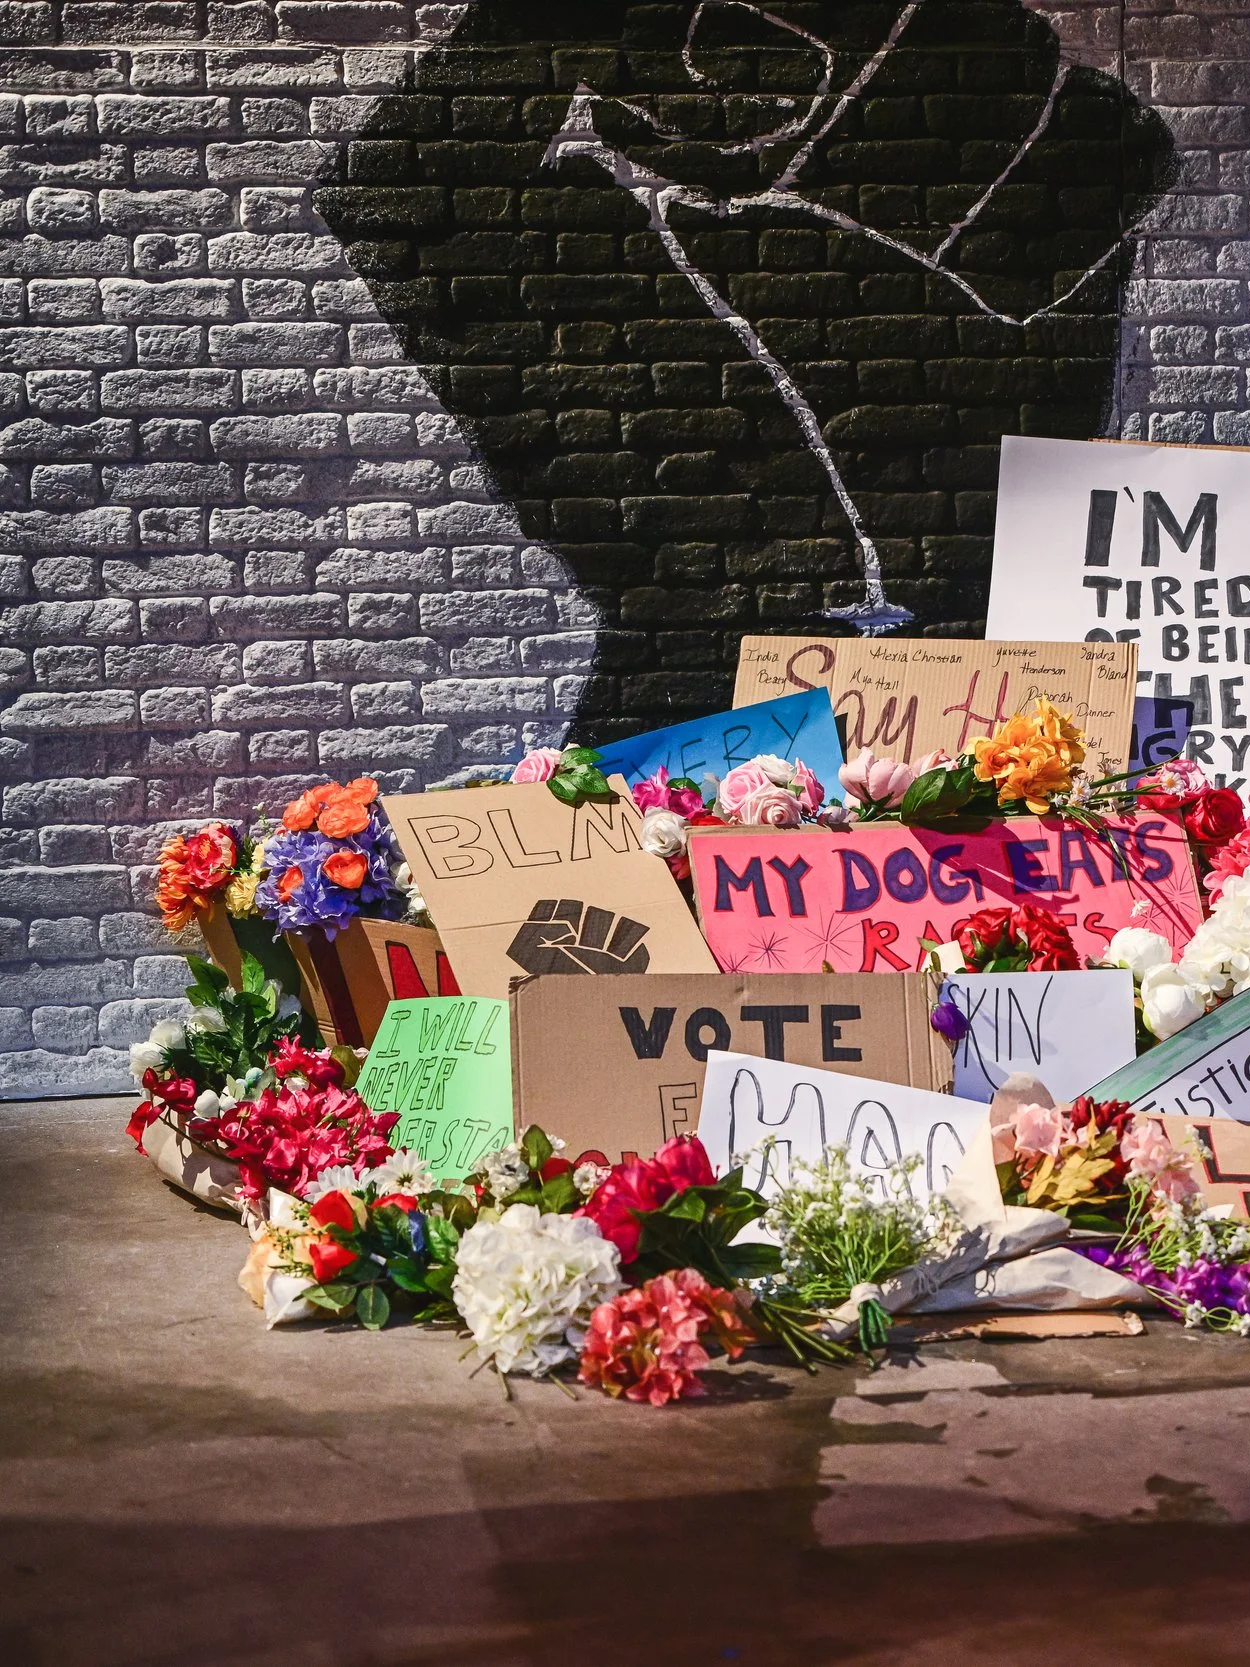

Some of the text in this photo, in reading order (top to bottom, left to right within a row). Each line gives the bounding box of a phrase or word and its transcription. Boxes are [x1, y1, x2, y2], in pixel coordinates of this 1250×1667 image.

[743, 648, 779, 662] India
[870, 646, 963, 664] Alexia Christian
[1080, 647, 1116, 661] Sandra
[1020, 663, 1066, 675] Henderson
[1097, 665, 1128, 680] Bland
[875, 679, 899, 690] Hall
[407, 795, 645, 879] BLM
[713, 821, 1175, 918] MY DOG EATS
[376, 1001, 502, 1058] I WILL
[619, 1004, 863, 1062] VOTE
[362, 1056, 458, 1111] NEVER
